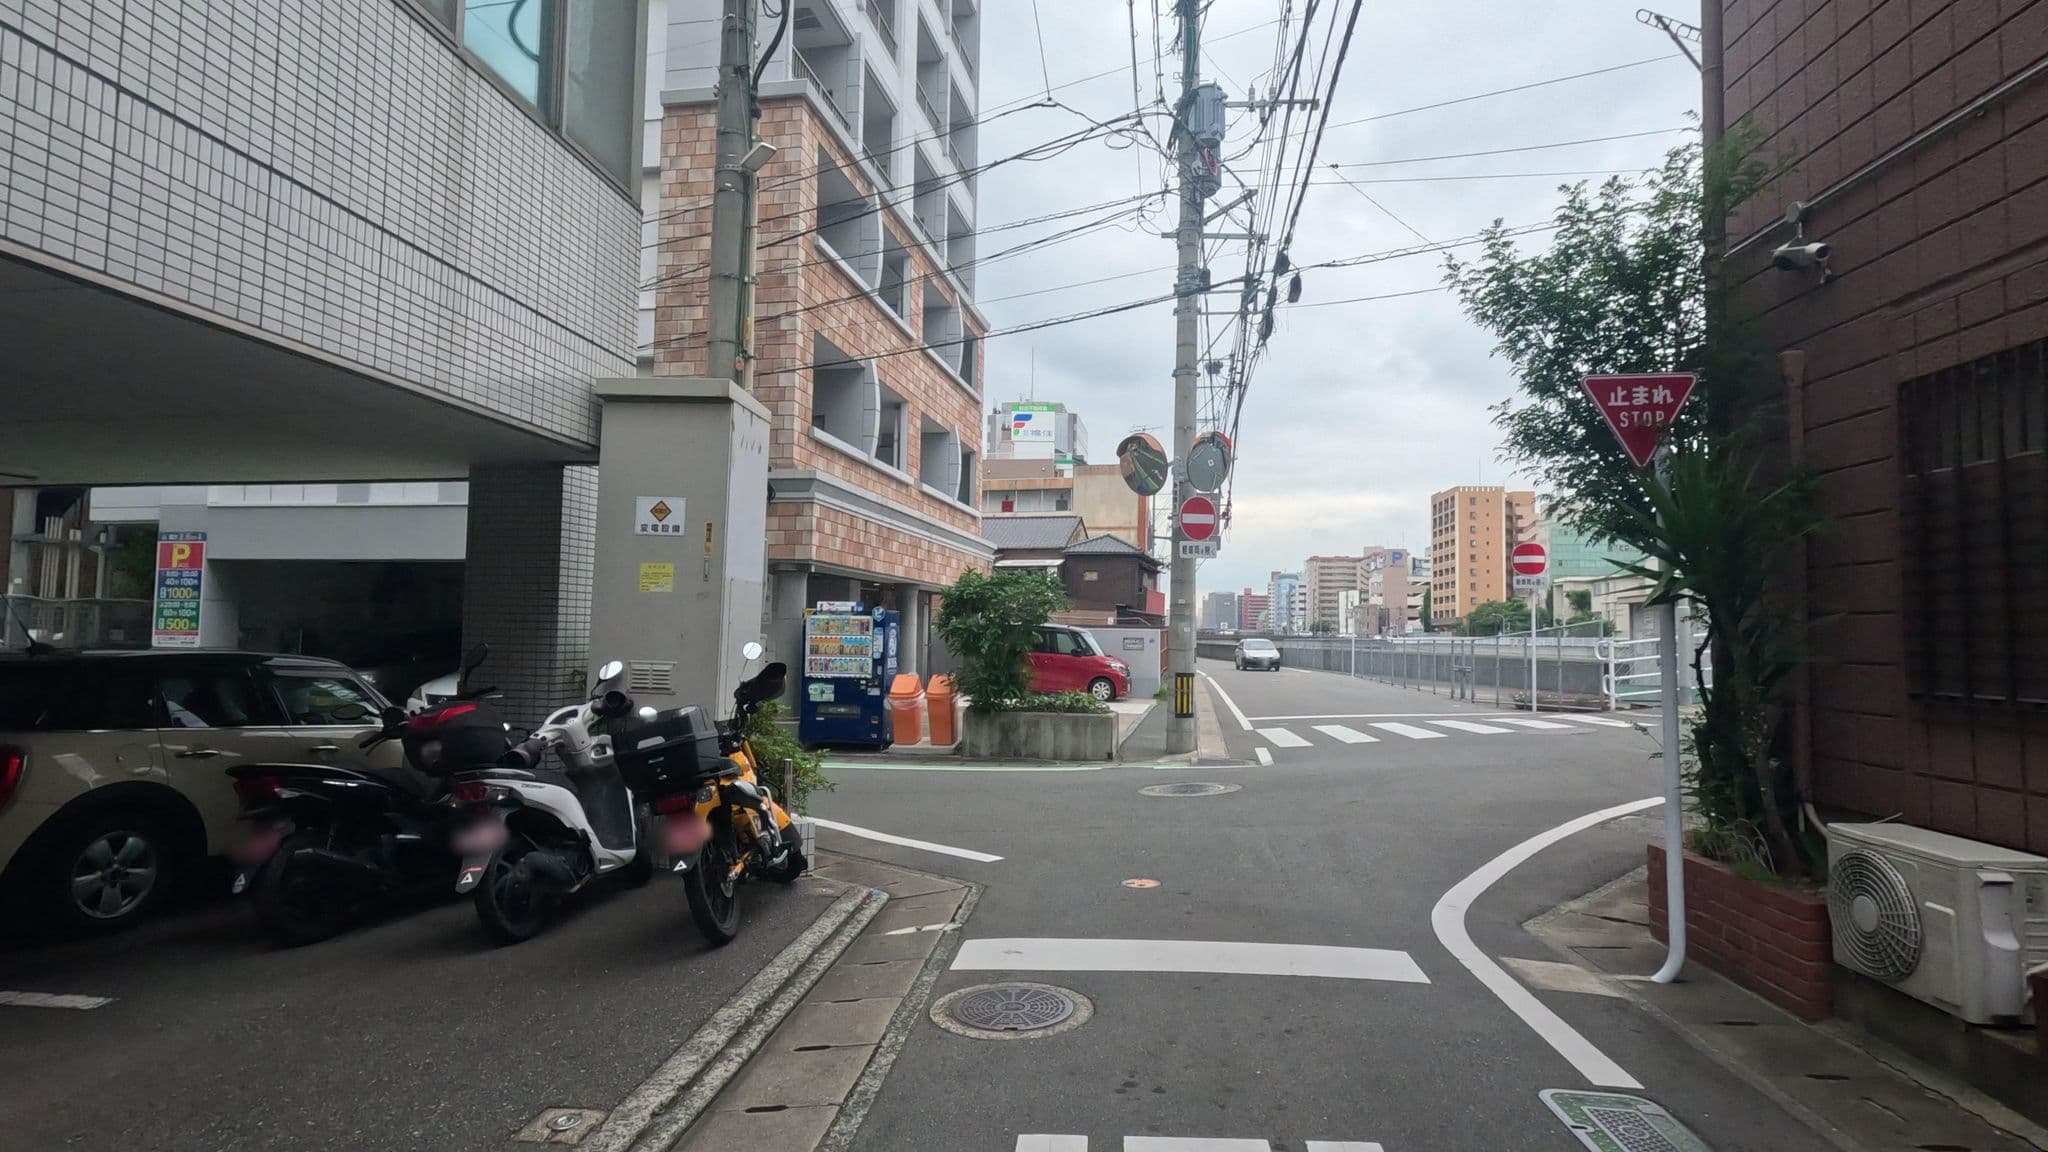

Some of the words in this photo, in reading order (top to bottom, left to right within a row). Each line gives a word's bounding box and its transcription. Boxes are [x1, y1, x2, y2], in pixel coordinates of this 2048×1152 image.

[1607, 385, 1674, 406] 止まれ
[1619, 410, 1665, 428] STOP
[171, 543, 191, 568] P
[1391, 551, 1404, 566] P
